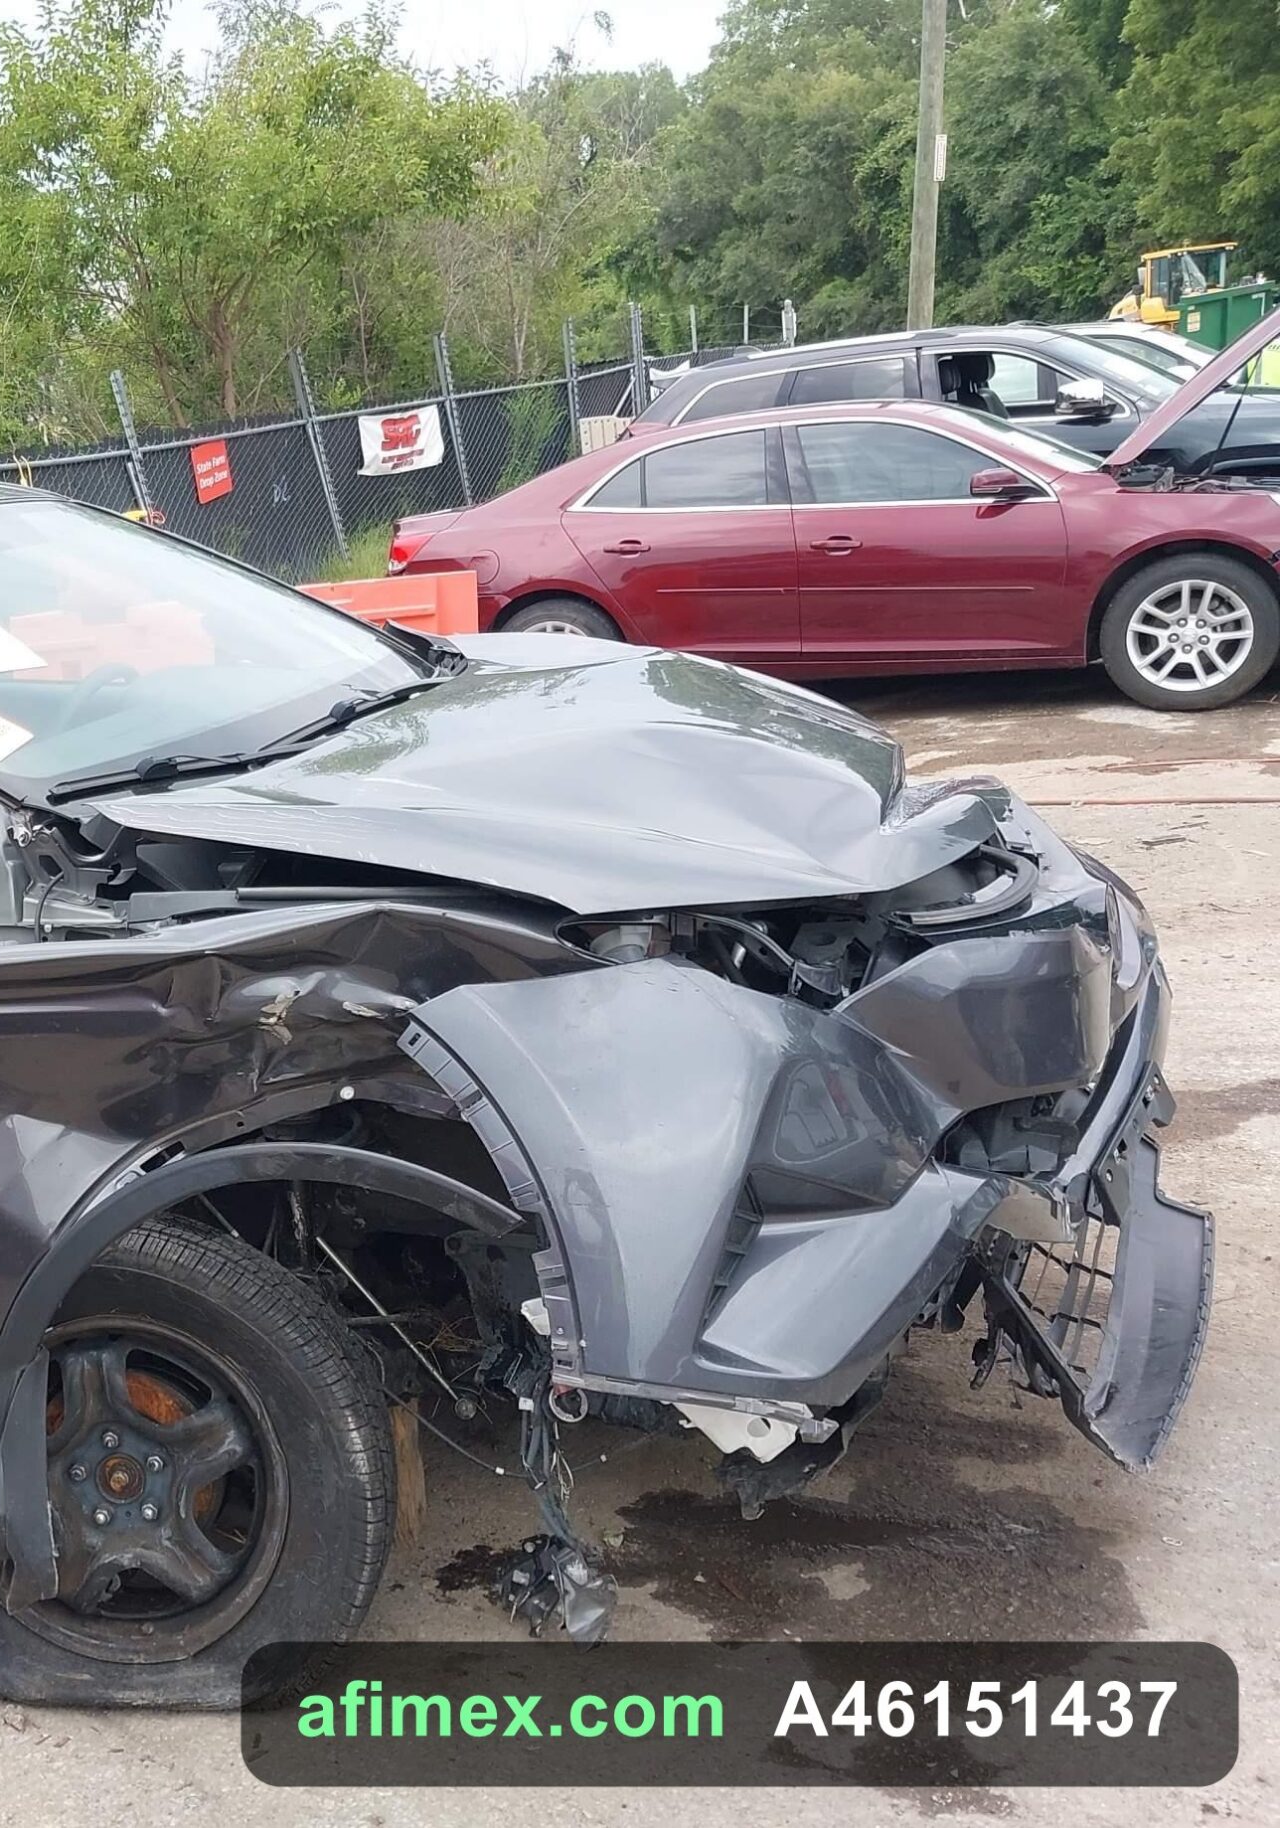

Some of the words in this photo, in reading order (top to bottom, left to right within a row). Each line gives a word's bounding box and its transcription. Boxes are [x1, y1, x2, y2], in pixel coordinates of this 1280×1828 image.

[196, 459, 212, 475] State
[212, 455, 226, 468] Farm
[199, 475, 215, 489] Drop
[214, 470, 228, 483] Zone
